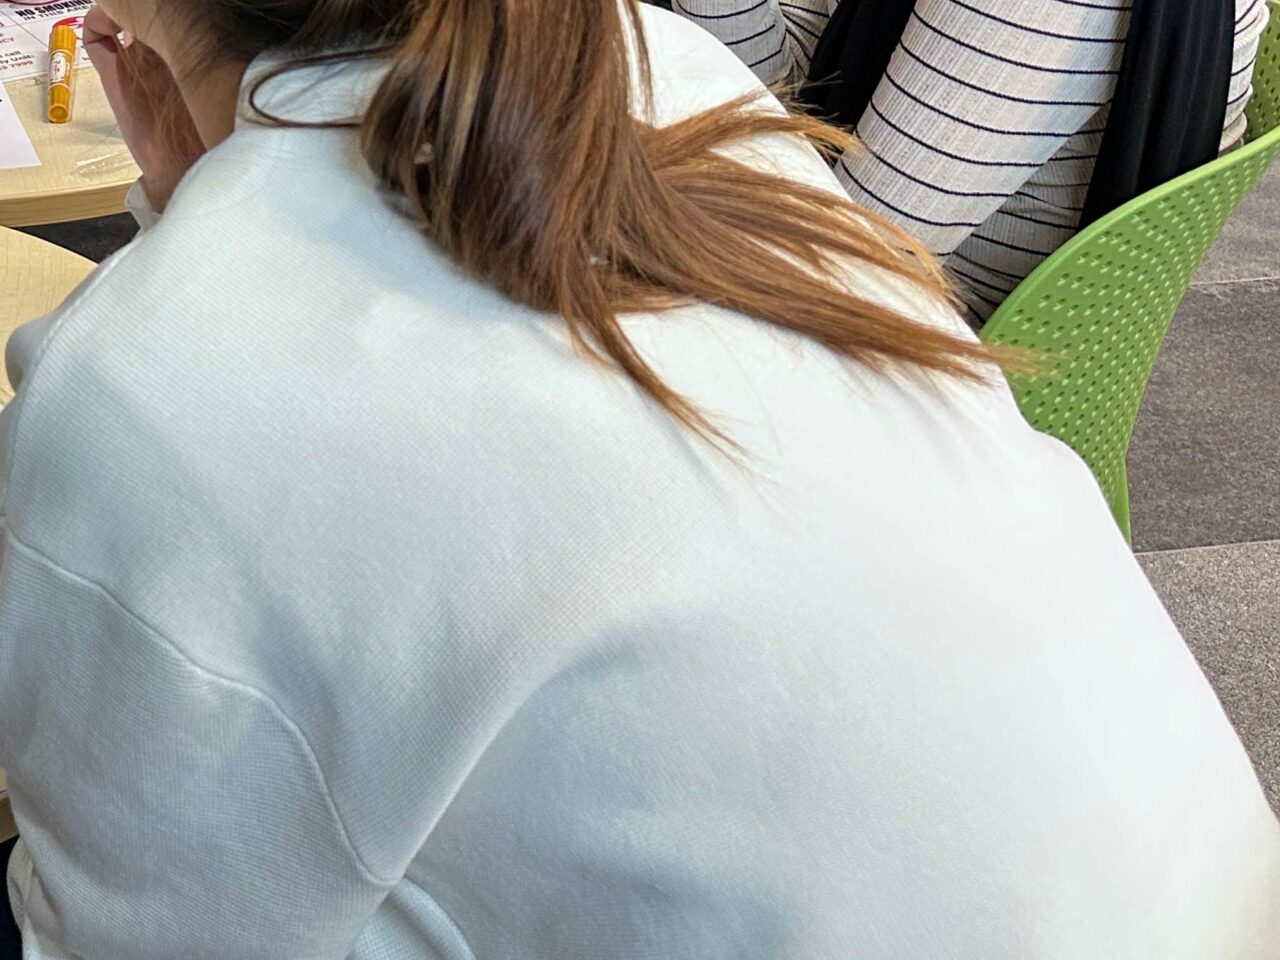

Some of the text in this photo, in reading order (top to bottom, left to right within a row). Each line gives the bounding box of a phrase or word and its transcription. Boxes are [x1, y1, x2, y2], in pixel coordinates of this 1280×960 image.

[14, 8, 36, 17] NO
[37, 10, 64, 18] THIS
[66, 4, 94, 12] ARE
